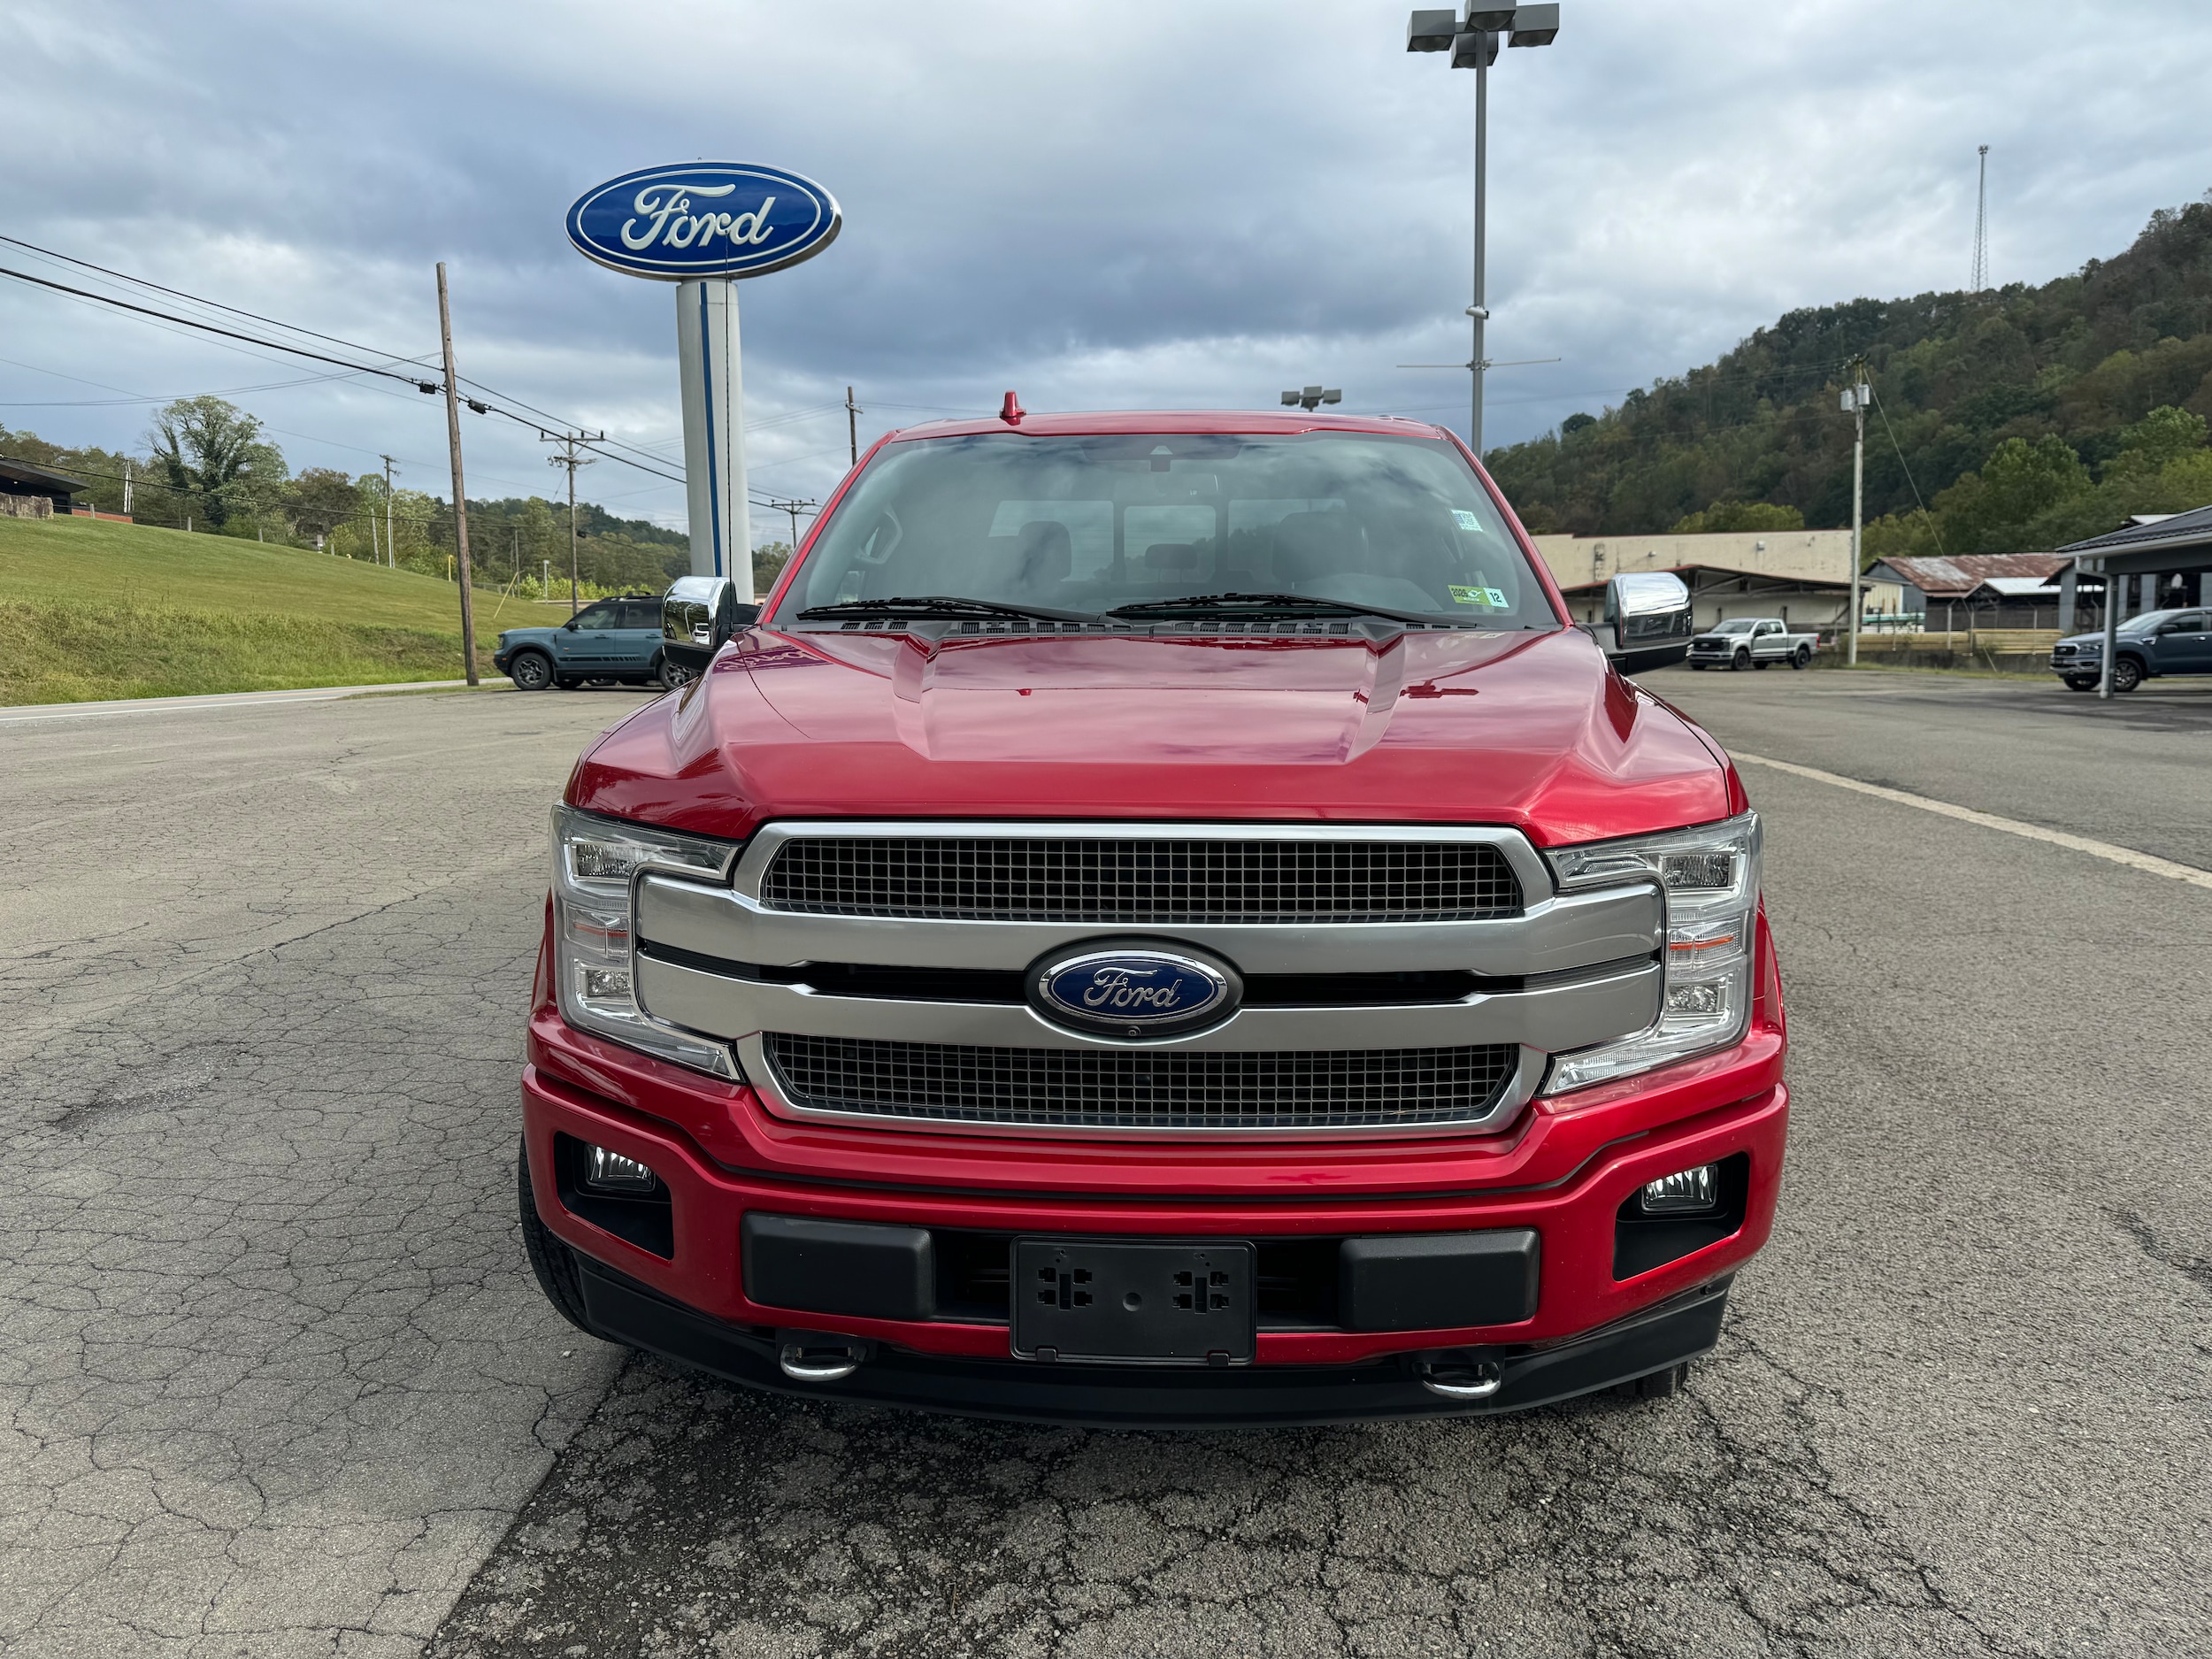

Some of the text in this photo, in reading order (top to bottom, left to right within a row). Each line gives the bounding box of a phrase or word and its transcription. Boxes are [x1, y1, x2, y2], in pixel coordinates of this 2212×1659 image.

[620, 183, 777, 250] Ford
[1489, 592, 1502, 603] 12
[1083, 966, 1183, 1008] Ford
